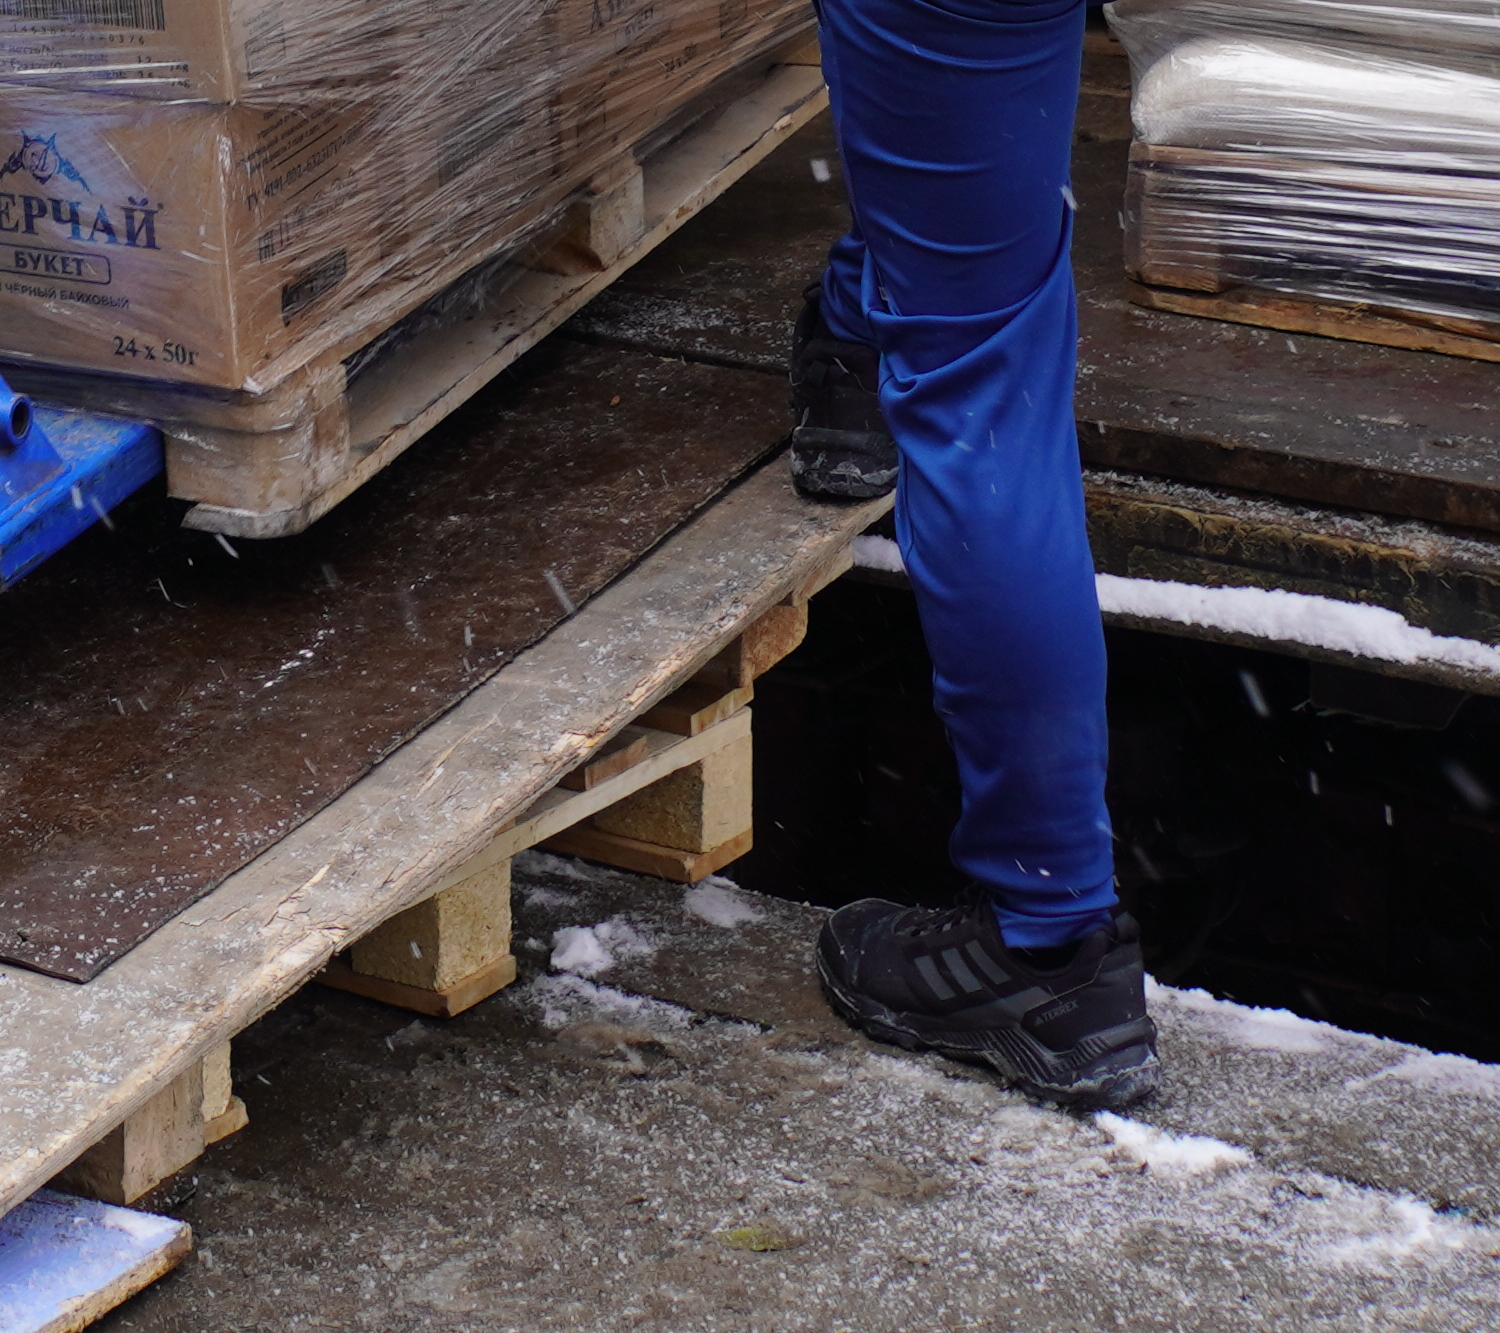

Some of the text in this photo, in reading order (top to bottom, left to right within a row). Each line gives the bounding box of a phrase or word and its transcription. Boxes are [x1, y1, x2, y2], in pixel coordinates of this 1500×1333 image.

[14, 250, 84, 277] БУКЕТ
[59, 290, 130, 310] БАЙХОВЫЙ
[113, 335, 141, 356] 24
[162, 341, 199, 366] 50г
